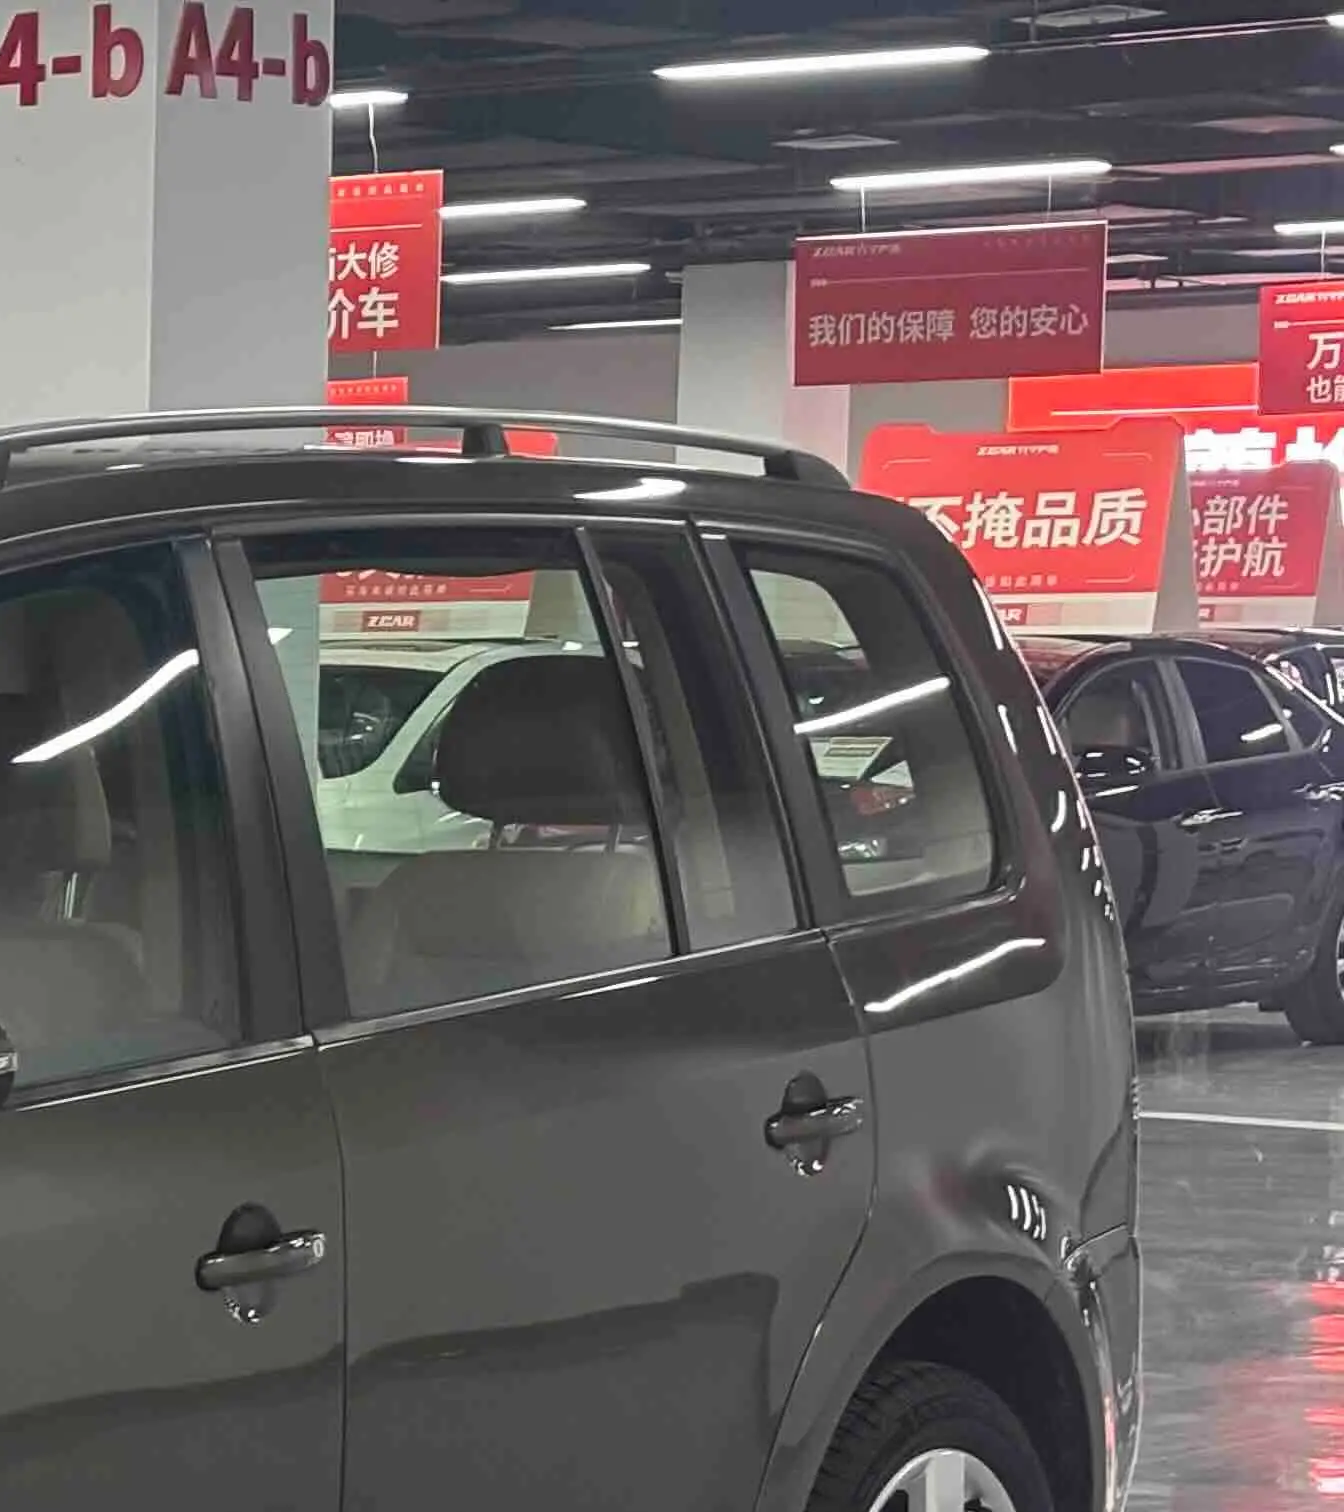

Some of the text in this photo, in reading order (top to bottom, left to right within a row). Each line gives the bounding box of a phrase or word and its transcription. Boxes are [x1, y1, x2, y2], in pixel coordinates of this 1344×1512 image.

[164, 2, 330, 106] A4-b
[808, 303, 1089, 347] 我们的保障 您的安心
[1192, 494, 1289, 536] 部件
[1193, 535, 1288, 578] 护航
[367, 615, 415, 628] ZCAR
